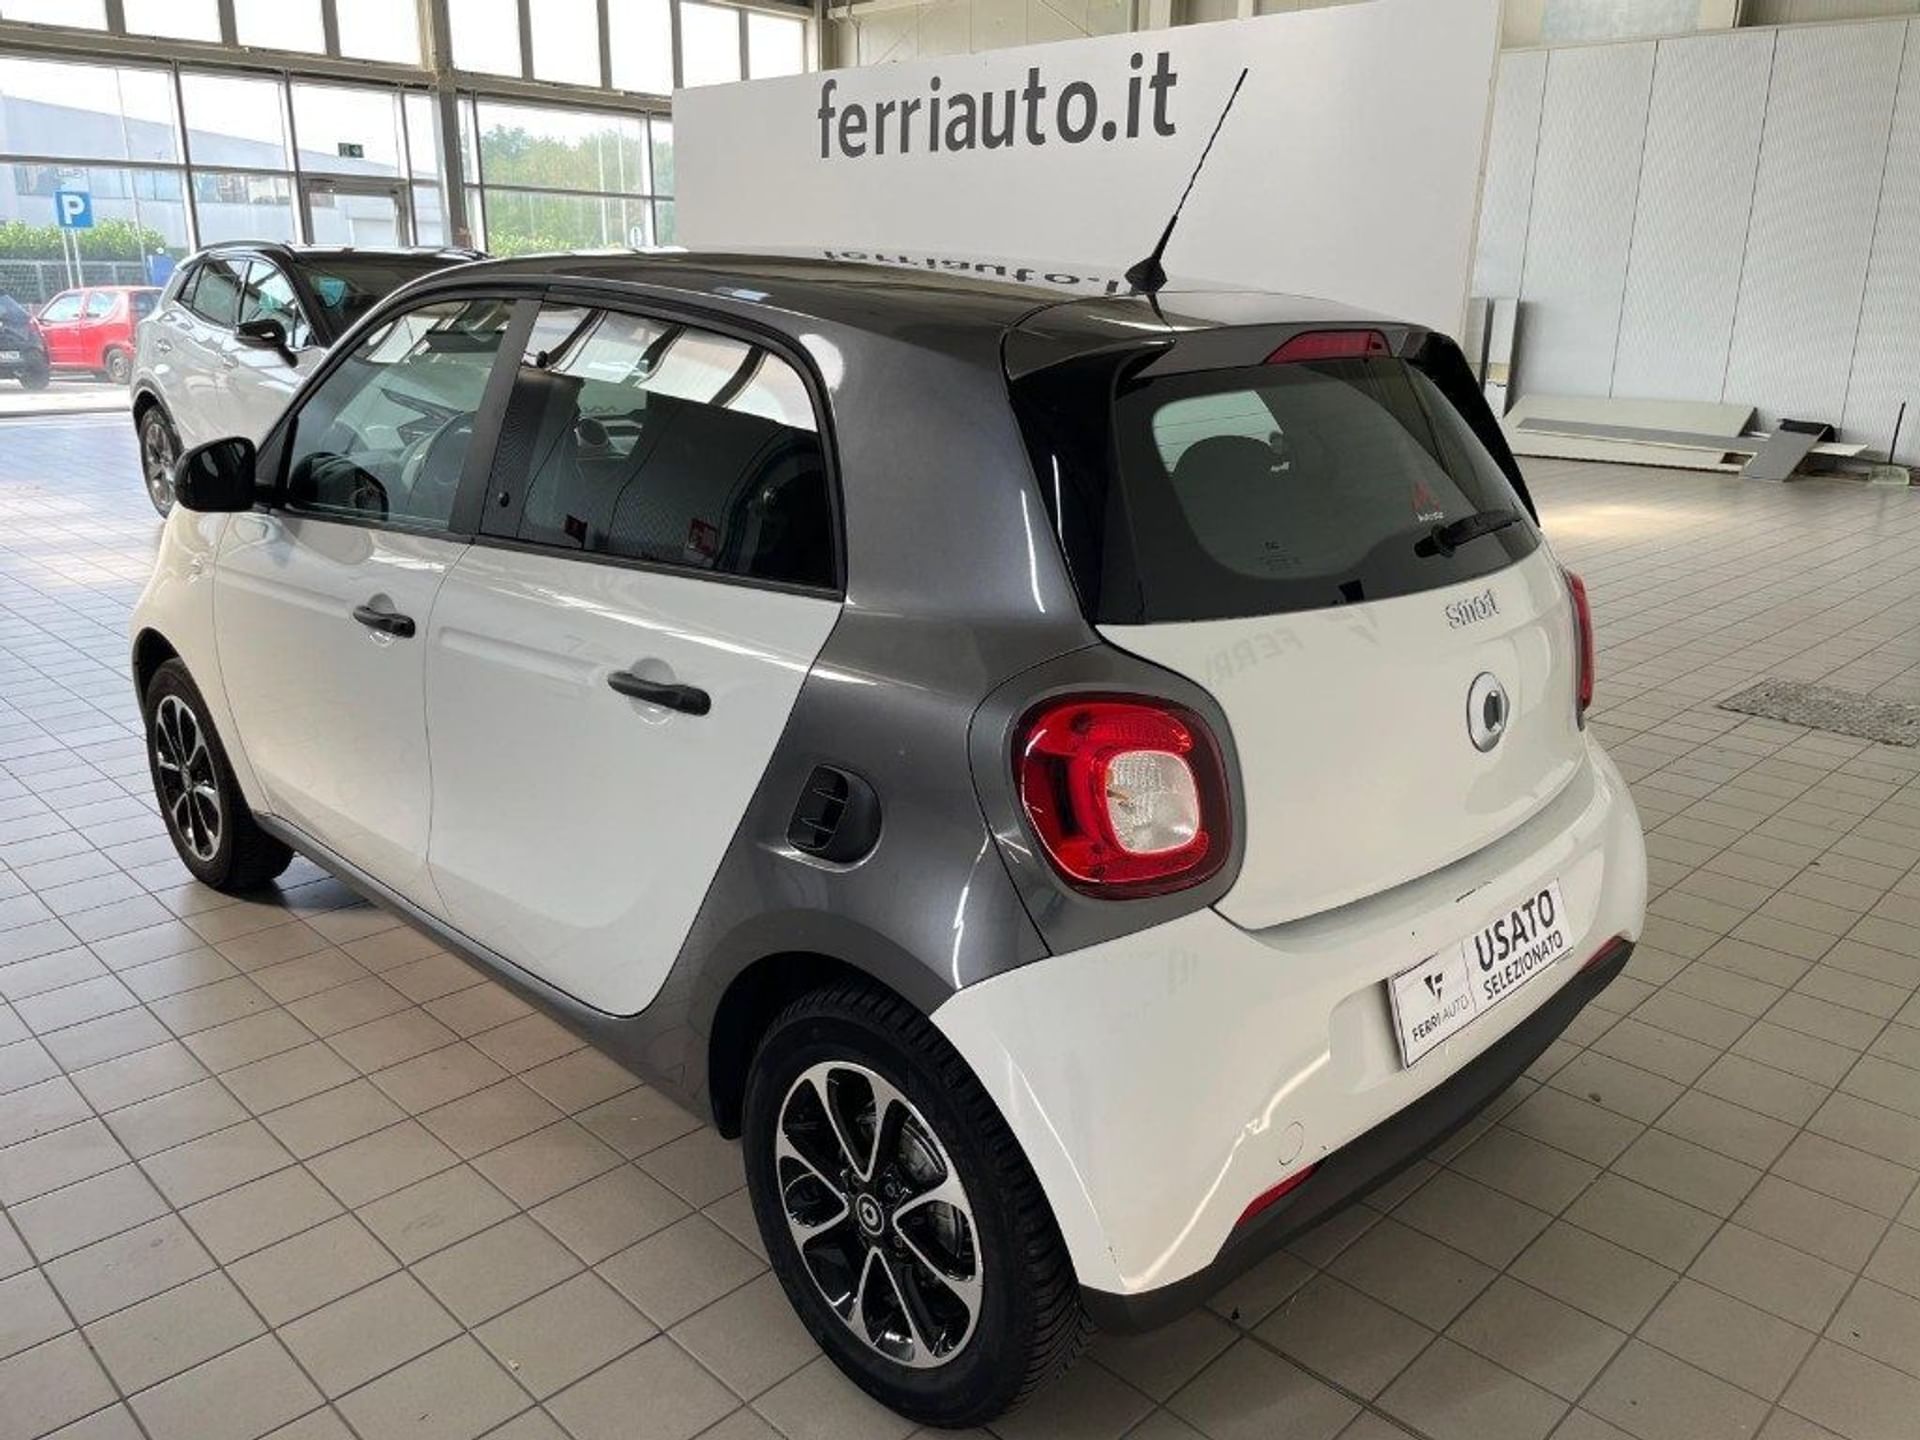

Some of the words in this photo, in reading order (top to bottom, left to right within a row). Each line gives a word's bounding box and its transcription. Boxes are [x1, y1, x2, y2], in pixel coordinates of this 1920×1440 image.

[817, 52, 1178, 158] ferriauto.it
[62, 195, 84, 224] P
[1474, 889, 1555, 972] USATO
[1483, 929, 1563, 1001] SELEZIONATO
[1412, 1013, 1441, 1042] FERRI
[1441, 995, 1470, 1021] AUTO
